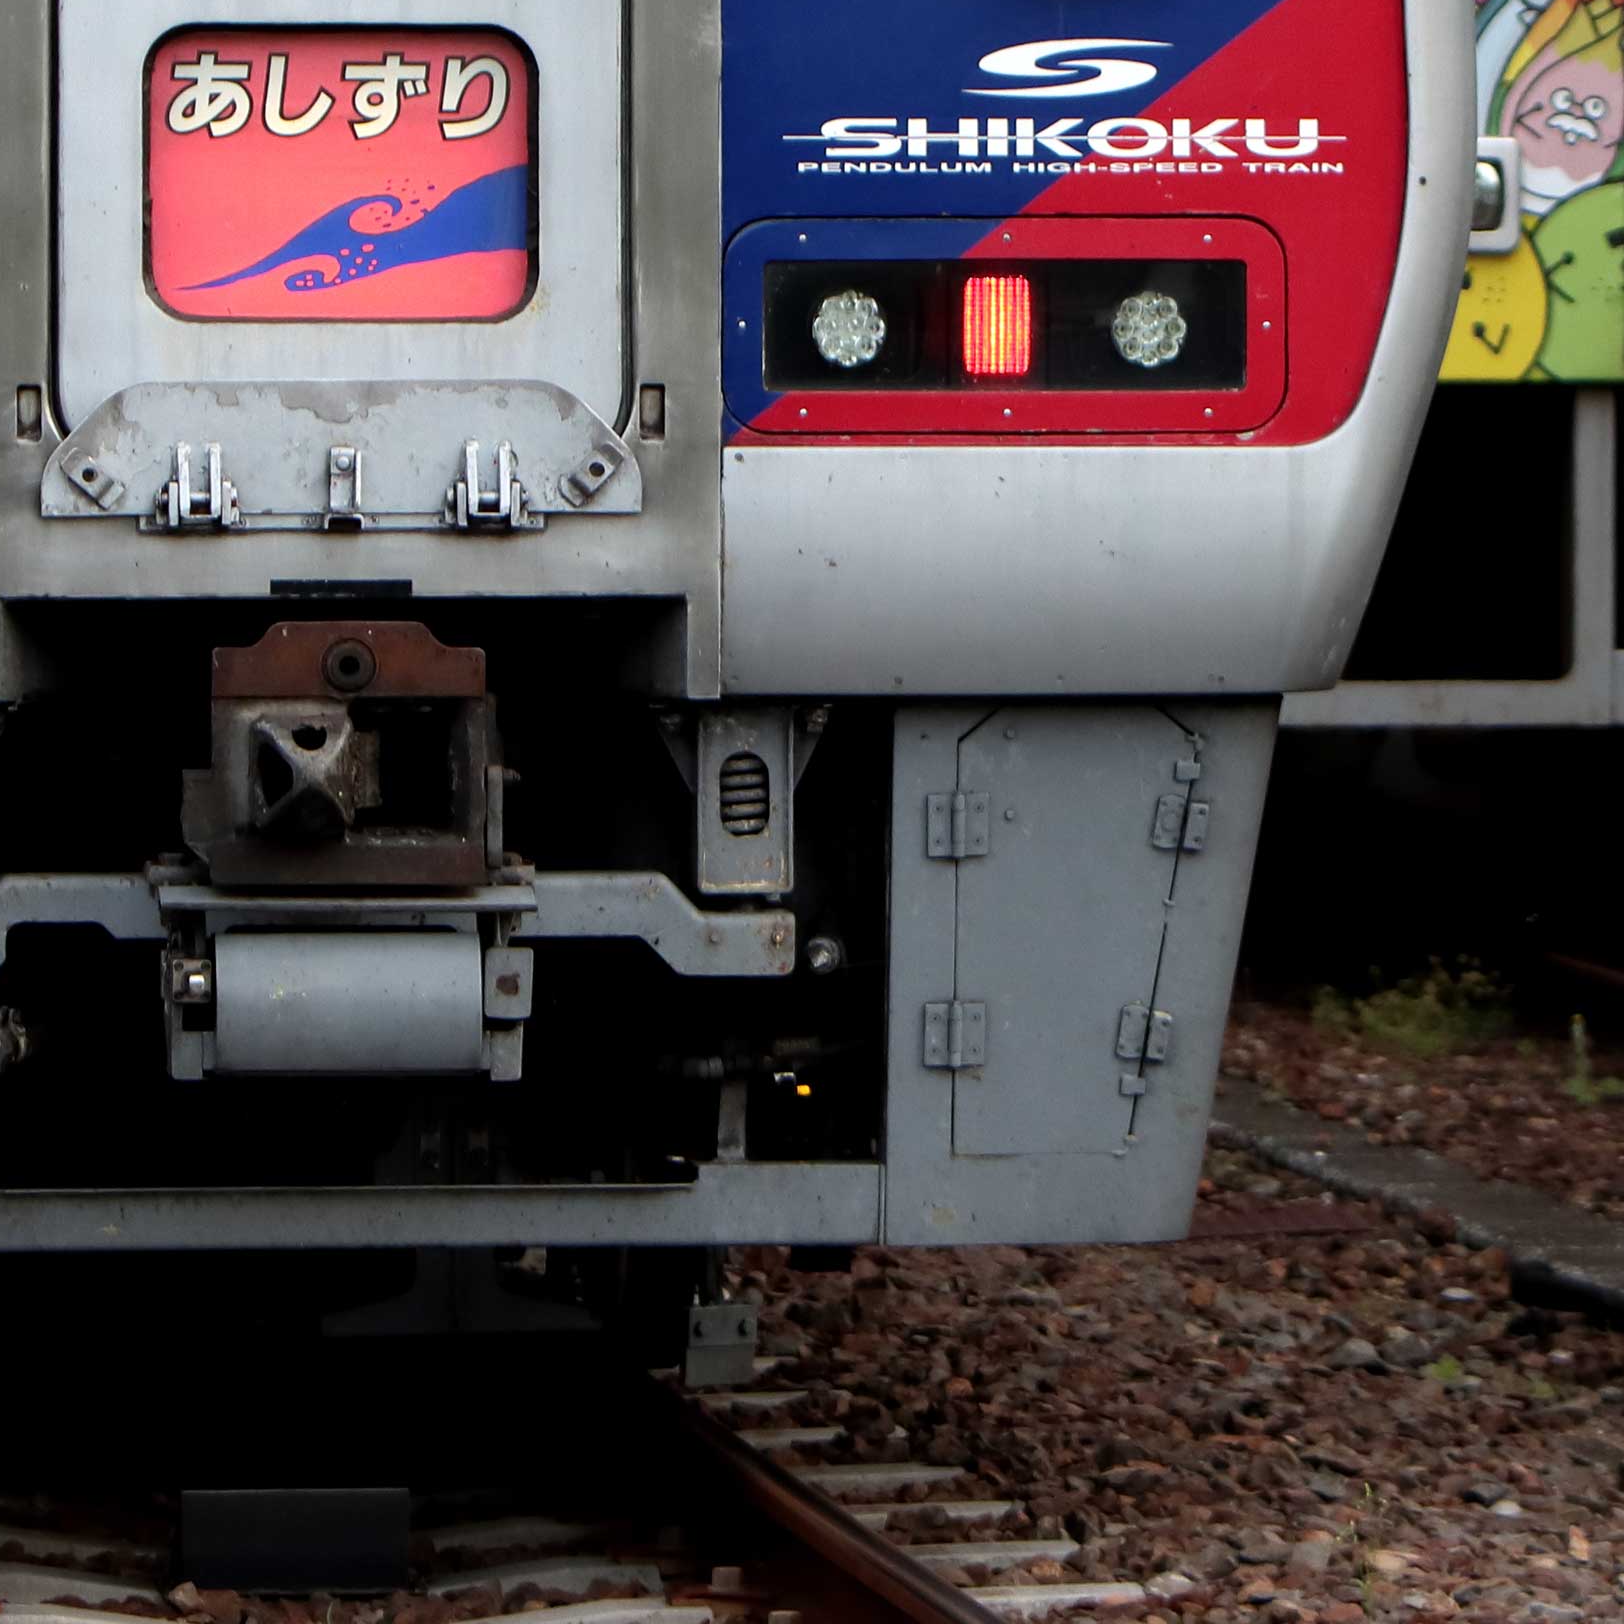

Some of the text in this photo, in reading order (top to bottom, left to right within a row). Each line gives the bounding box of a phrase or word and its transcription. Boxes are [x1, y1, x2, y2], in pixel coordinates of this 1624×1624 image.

[166, 50, 512, 141] あしずり
[820, 117, 1319, 158] SHIKOKU
[797, 161, 1345, 174] PENDULUM HIGH-SPEED TRAIN
